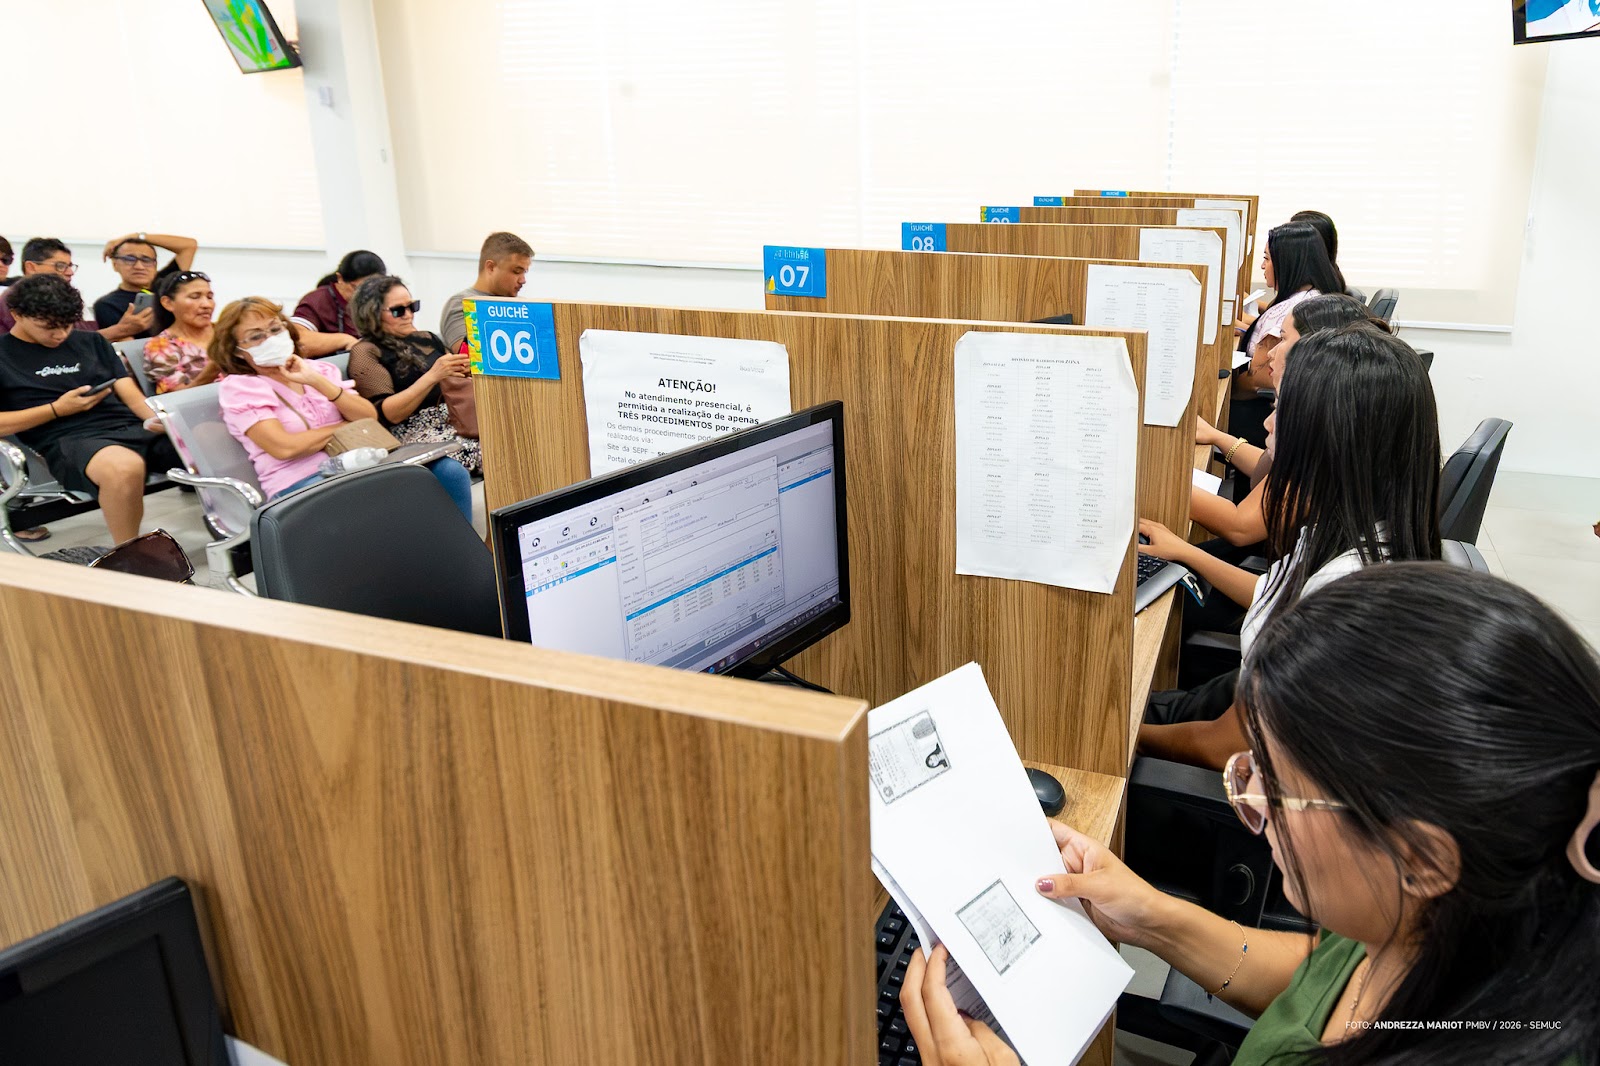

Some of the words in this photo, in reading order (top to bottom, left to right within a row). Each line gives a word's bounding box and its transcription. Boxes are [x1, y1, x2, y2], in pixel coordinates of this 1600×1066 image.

[912, 236, 935, 251] 08
[779, 264, 810, 288] 07
[487, 304, 529, 319] GUICHÊ
[490, 329, 535, 365] 06
[658, 378, 716, 393] ATENÇÃO!
[624, 390, 636, 399] No
[638, 394, 693, 406] atendimento
[695, 400, 743, 412] presencial,
[746, 404, 752, 413] é
[618, 401, 658, 413] permitida
[667, 408, 712, 420] realização
[714, 413, 725, 421] de
[727, 415, 759, 425] apenas
[617, 410, 639, 420] TRÊS
[641, 414, 713, 430] PROCEDIMENTOS
[715, 424, 730, 432] por
[606, 432, 639, 442] realizados
[617, 424, 643, 433] demais
[644, 427, 696, 440] procedimentos
[607, 443, 620, 451] Site
[607, 455, 627, 464] Portal
[627, 457, 637, 465] do
